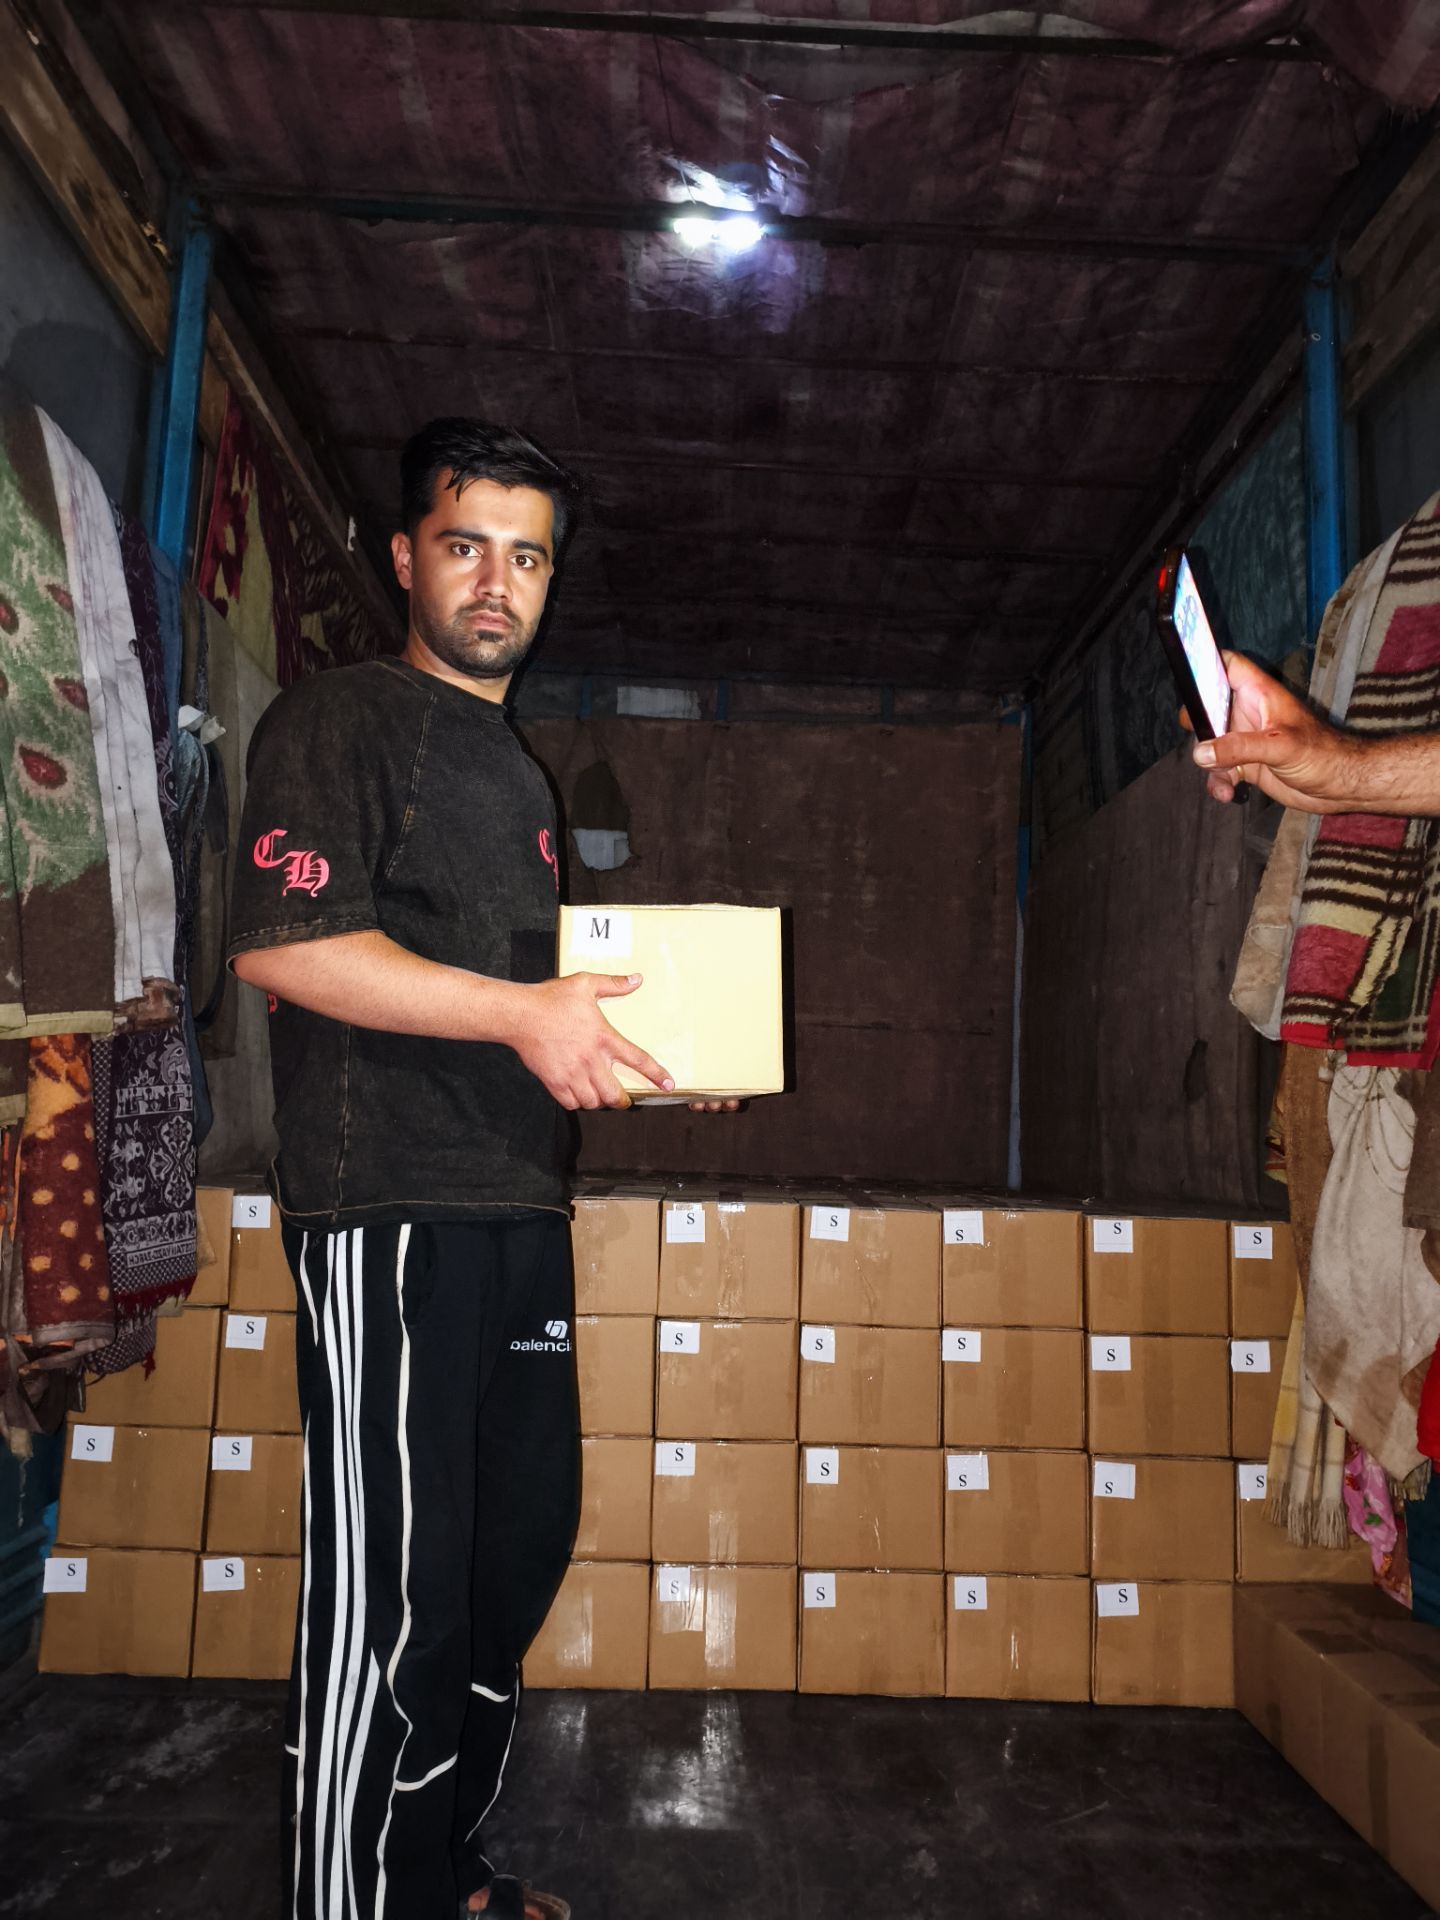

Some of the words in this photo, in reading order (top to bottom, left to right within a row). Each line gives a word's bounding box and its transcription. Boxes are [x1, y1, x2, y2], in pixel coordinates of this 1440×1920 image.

[589, 917, 611, 939] M
[248, 1205, 257, 1218] S
[686, 1212, 695, 1225] S
[829, 1215, 838, 1228] S
[1113, 1222, 1122, 1235] S
[955, 1229, 964, 1242] S
[1252, 1231, 1263, 1245] S
[245, 1321, 255, 1335] S
[675, 1332, 684, 1345] S
[814, 1338, 824, 1351] S
[957, 1337, 967, 1350] S
[1106, 1348, 1116, 1362] S
[1245, 1353, 1255, 1366] S
[86, 1437, 96, 1452] S
[231, 1441, 241, 1456] S
[675, 1447, 684, 1462] S
[820, 1461, 830, 1477] S
[958, 1474, 968, 1488] S
[1104, 1481, 1114, 1494] S
[1255, 1475, 1265, 1489] S
[66, 1563, 76, 1577] S
[224, 1562, 235, 1578] S
[670, 1579, 679, 1594] S
[816, 1586, 826, 1601] S
[967, 1590, 977, 1605] S
[1118, 1588, 1129, 1603] S
